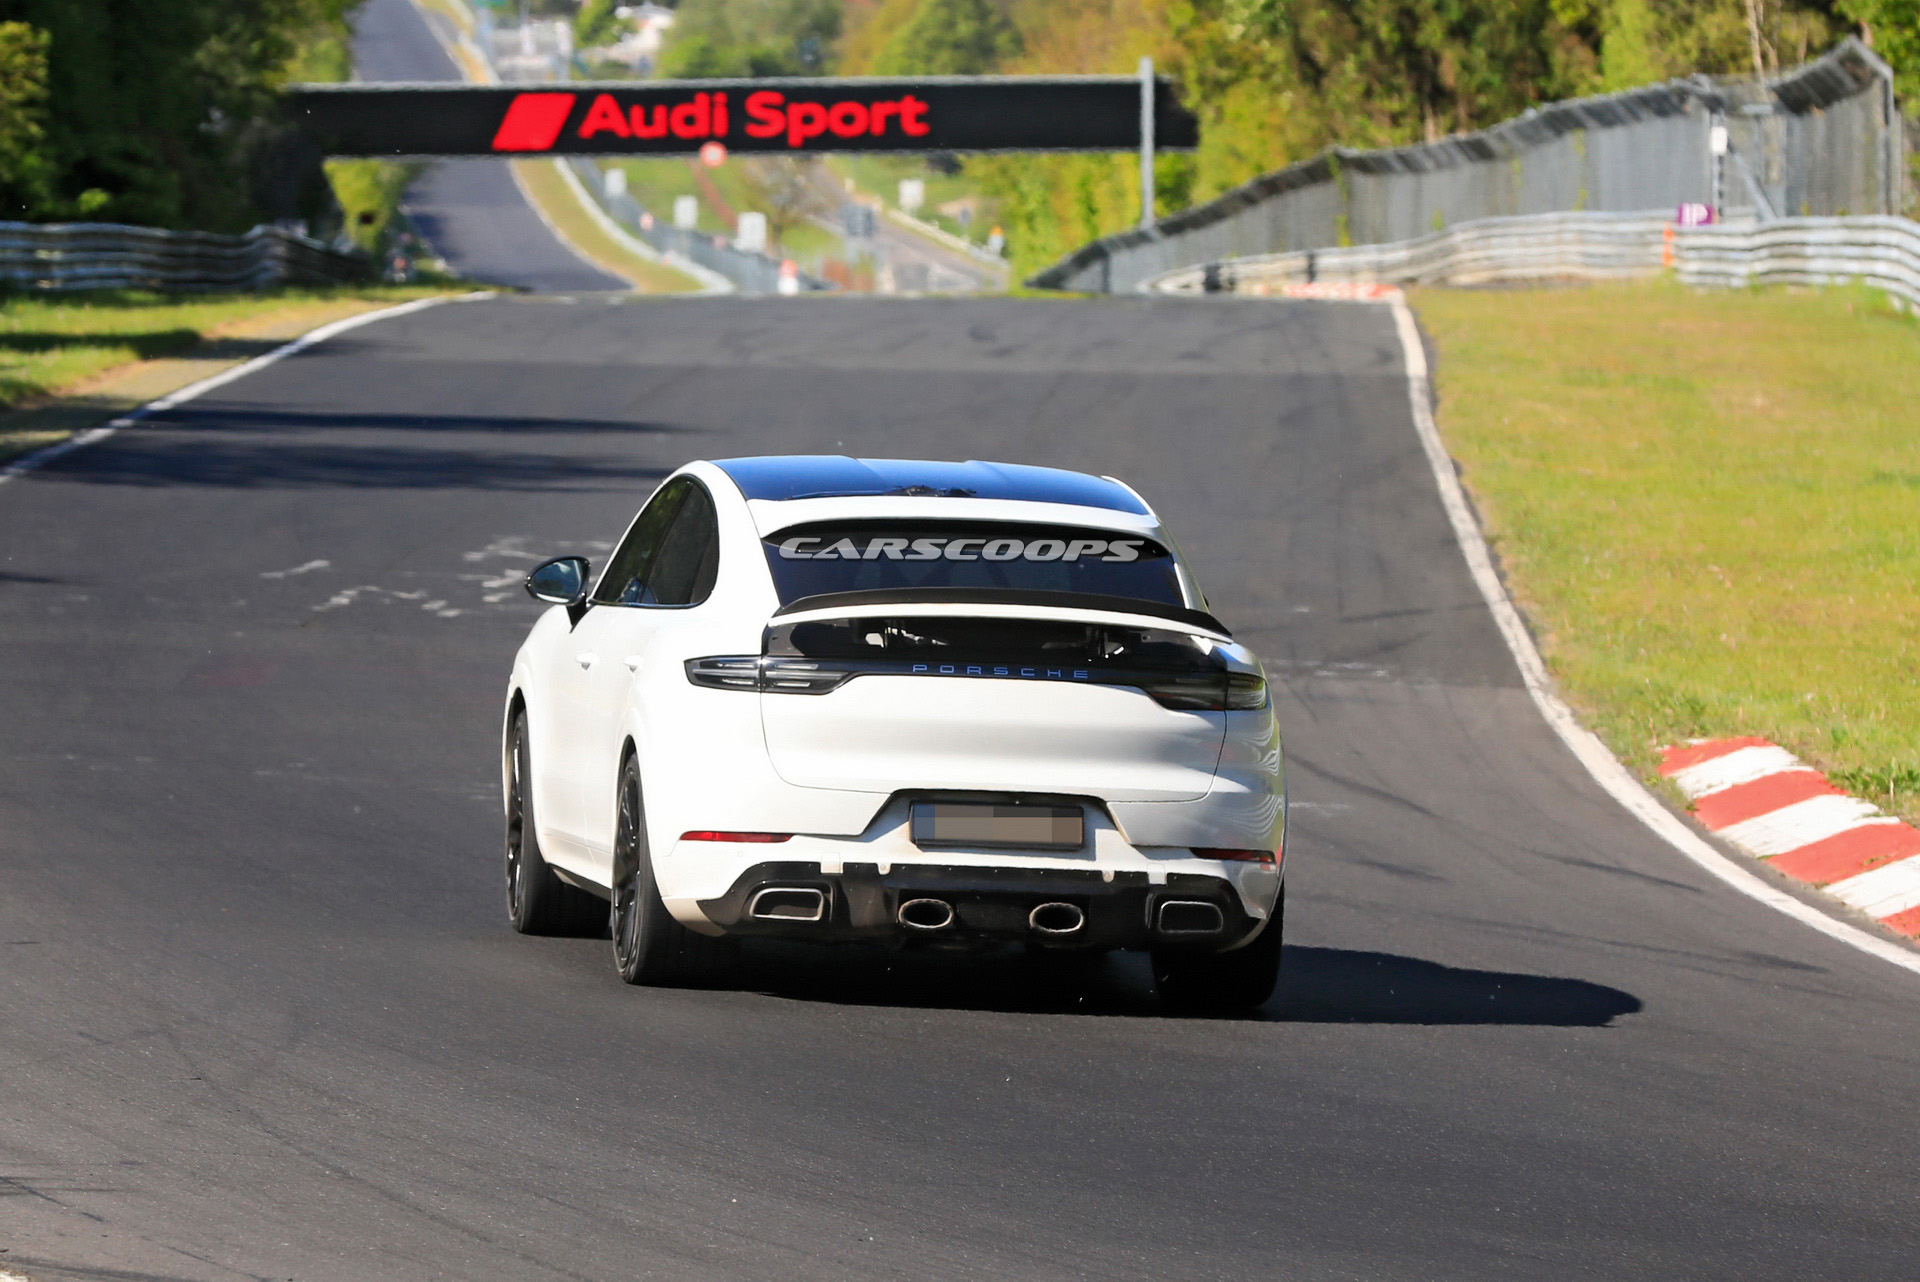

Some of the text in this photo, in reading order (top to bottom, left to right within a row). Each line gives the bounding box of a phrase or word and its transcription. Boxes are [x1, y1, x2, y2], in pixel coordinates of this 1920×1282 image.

[577, 91, 930, 148] Audi Sport
[912, 664, 1088, 679] PORSCHE
